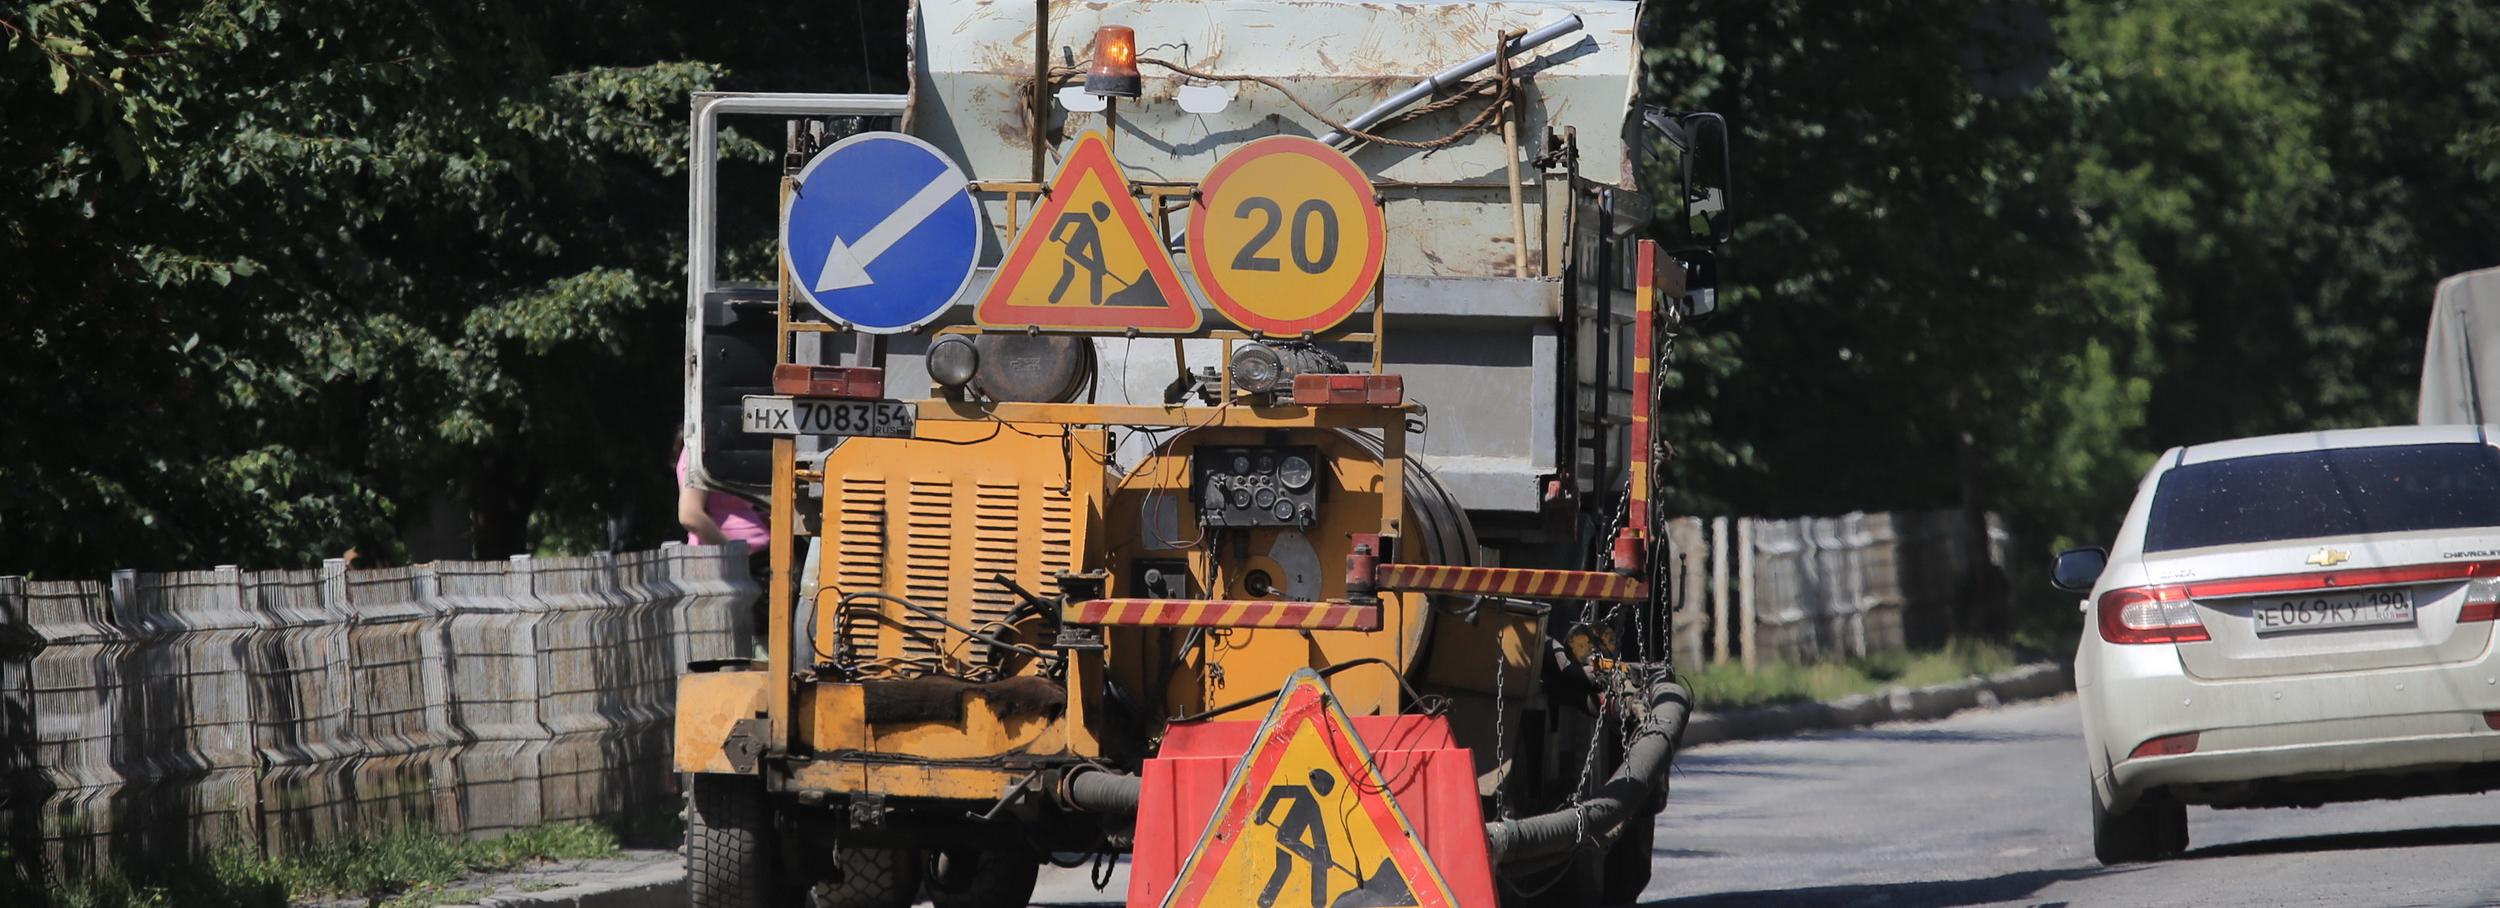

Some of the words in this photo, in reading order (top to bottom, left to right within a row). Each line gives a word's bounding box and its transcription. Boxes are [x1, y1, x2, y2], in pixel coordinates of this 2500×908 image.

[1231, 196, 1339, 275] 20
[798, 403, 870, 431] 7083
[877, 406, 907, 427] 54
[2368, 590, 2403, 611] 190
